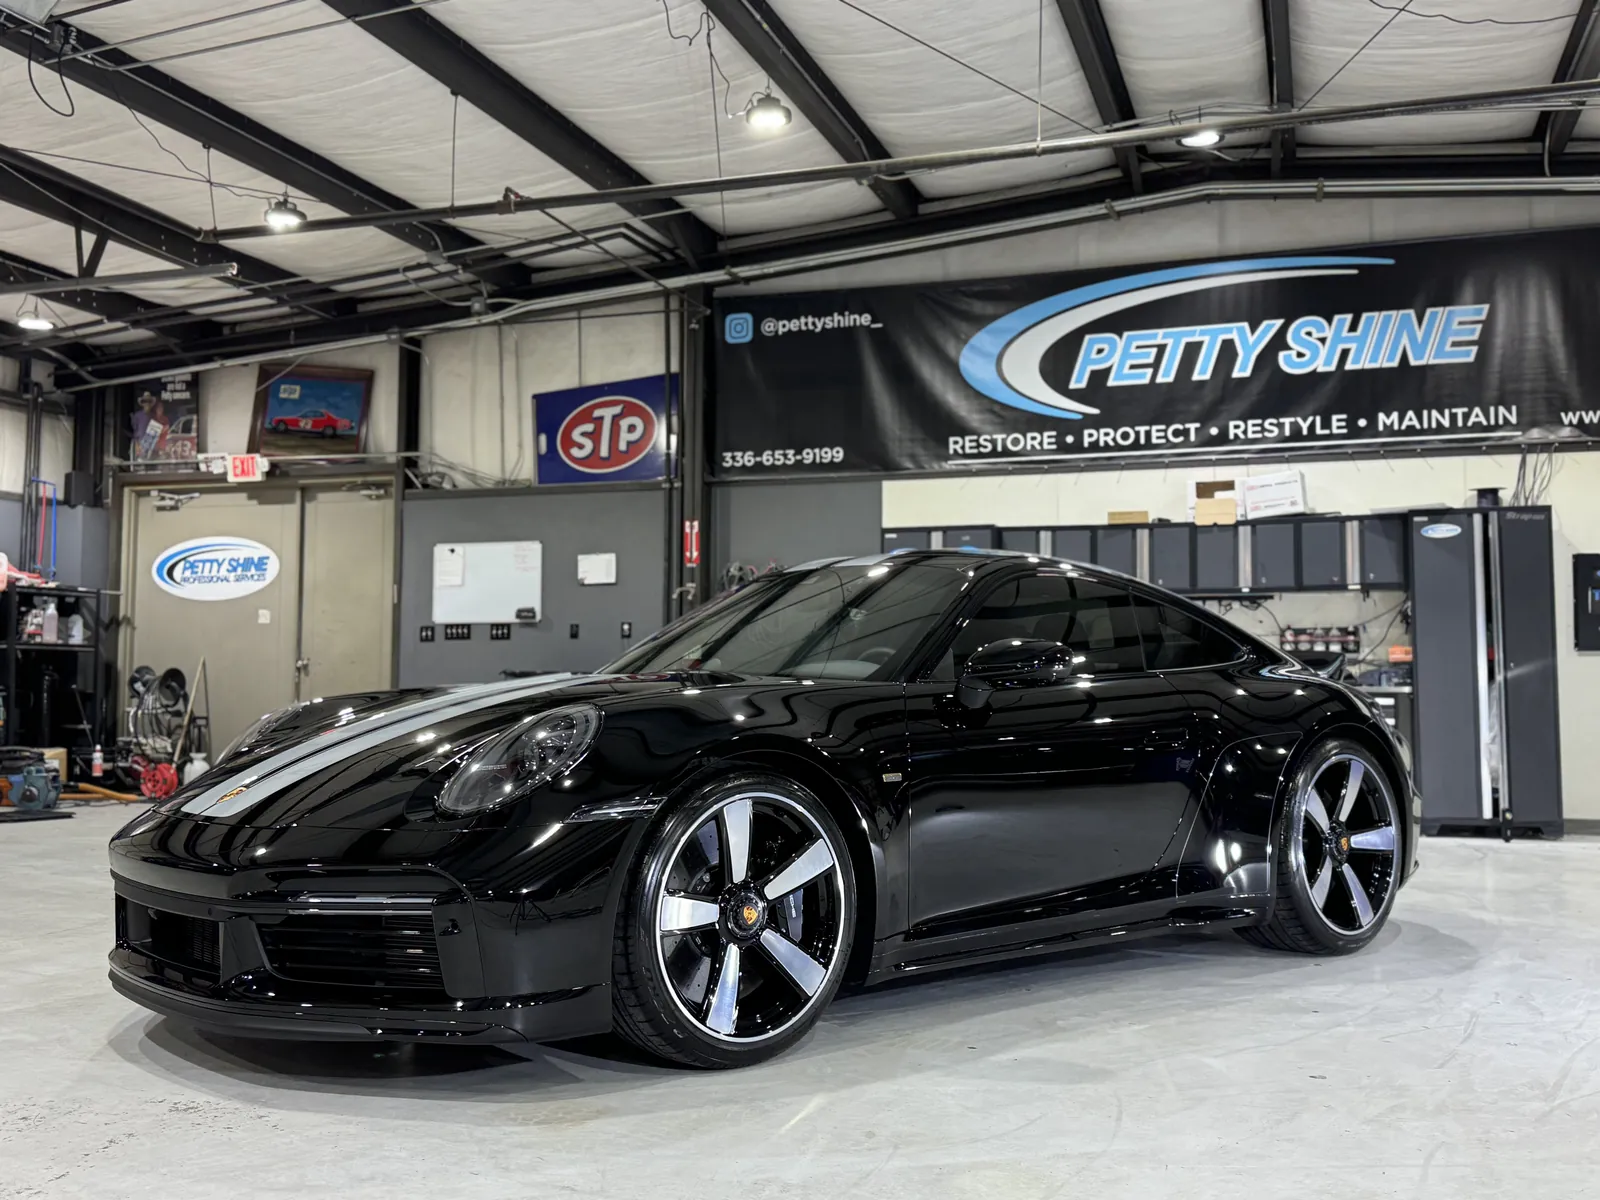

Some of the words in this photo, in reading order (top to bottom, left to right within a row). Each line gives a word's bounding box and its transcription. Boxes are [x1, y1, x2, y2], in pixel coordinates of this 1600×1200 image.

[761, 312, 883, 336] @pettyshine_
[1068, 319, 1285, 389] PETTY
[1277, 303, 1491, 376] SHINE
[569, 403, 645, 459] STP
[949, 431, 1058, 454] RESTORE
[1083, 423, 1200, 448] PROTECT
[1228, 414, 1348, 440] RESTYLE
[1377, 405, 1517, 432] MAINTAIN
[232, 456, 256, 477] EXIT
[721, 446, 845, 468] 336-653-9199
[182, 558, 226, 575] PETTY
[226, 555, 270, 574] SHINE
[180, 575, 231, 585] PROFESSIONAL
[233, 573, 266, 583] SERVICES
